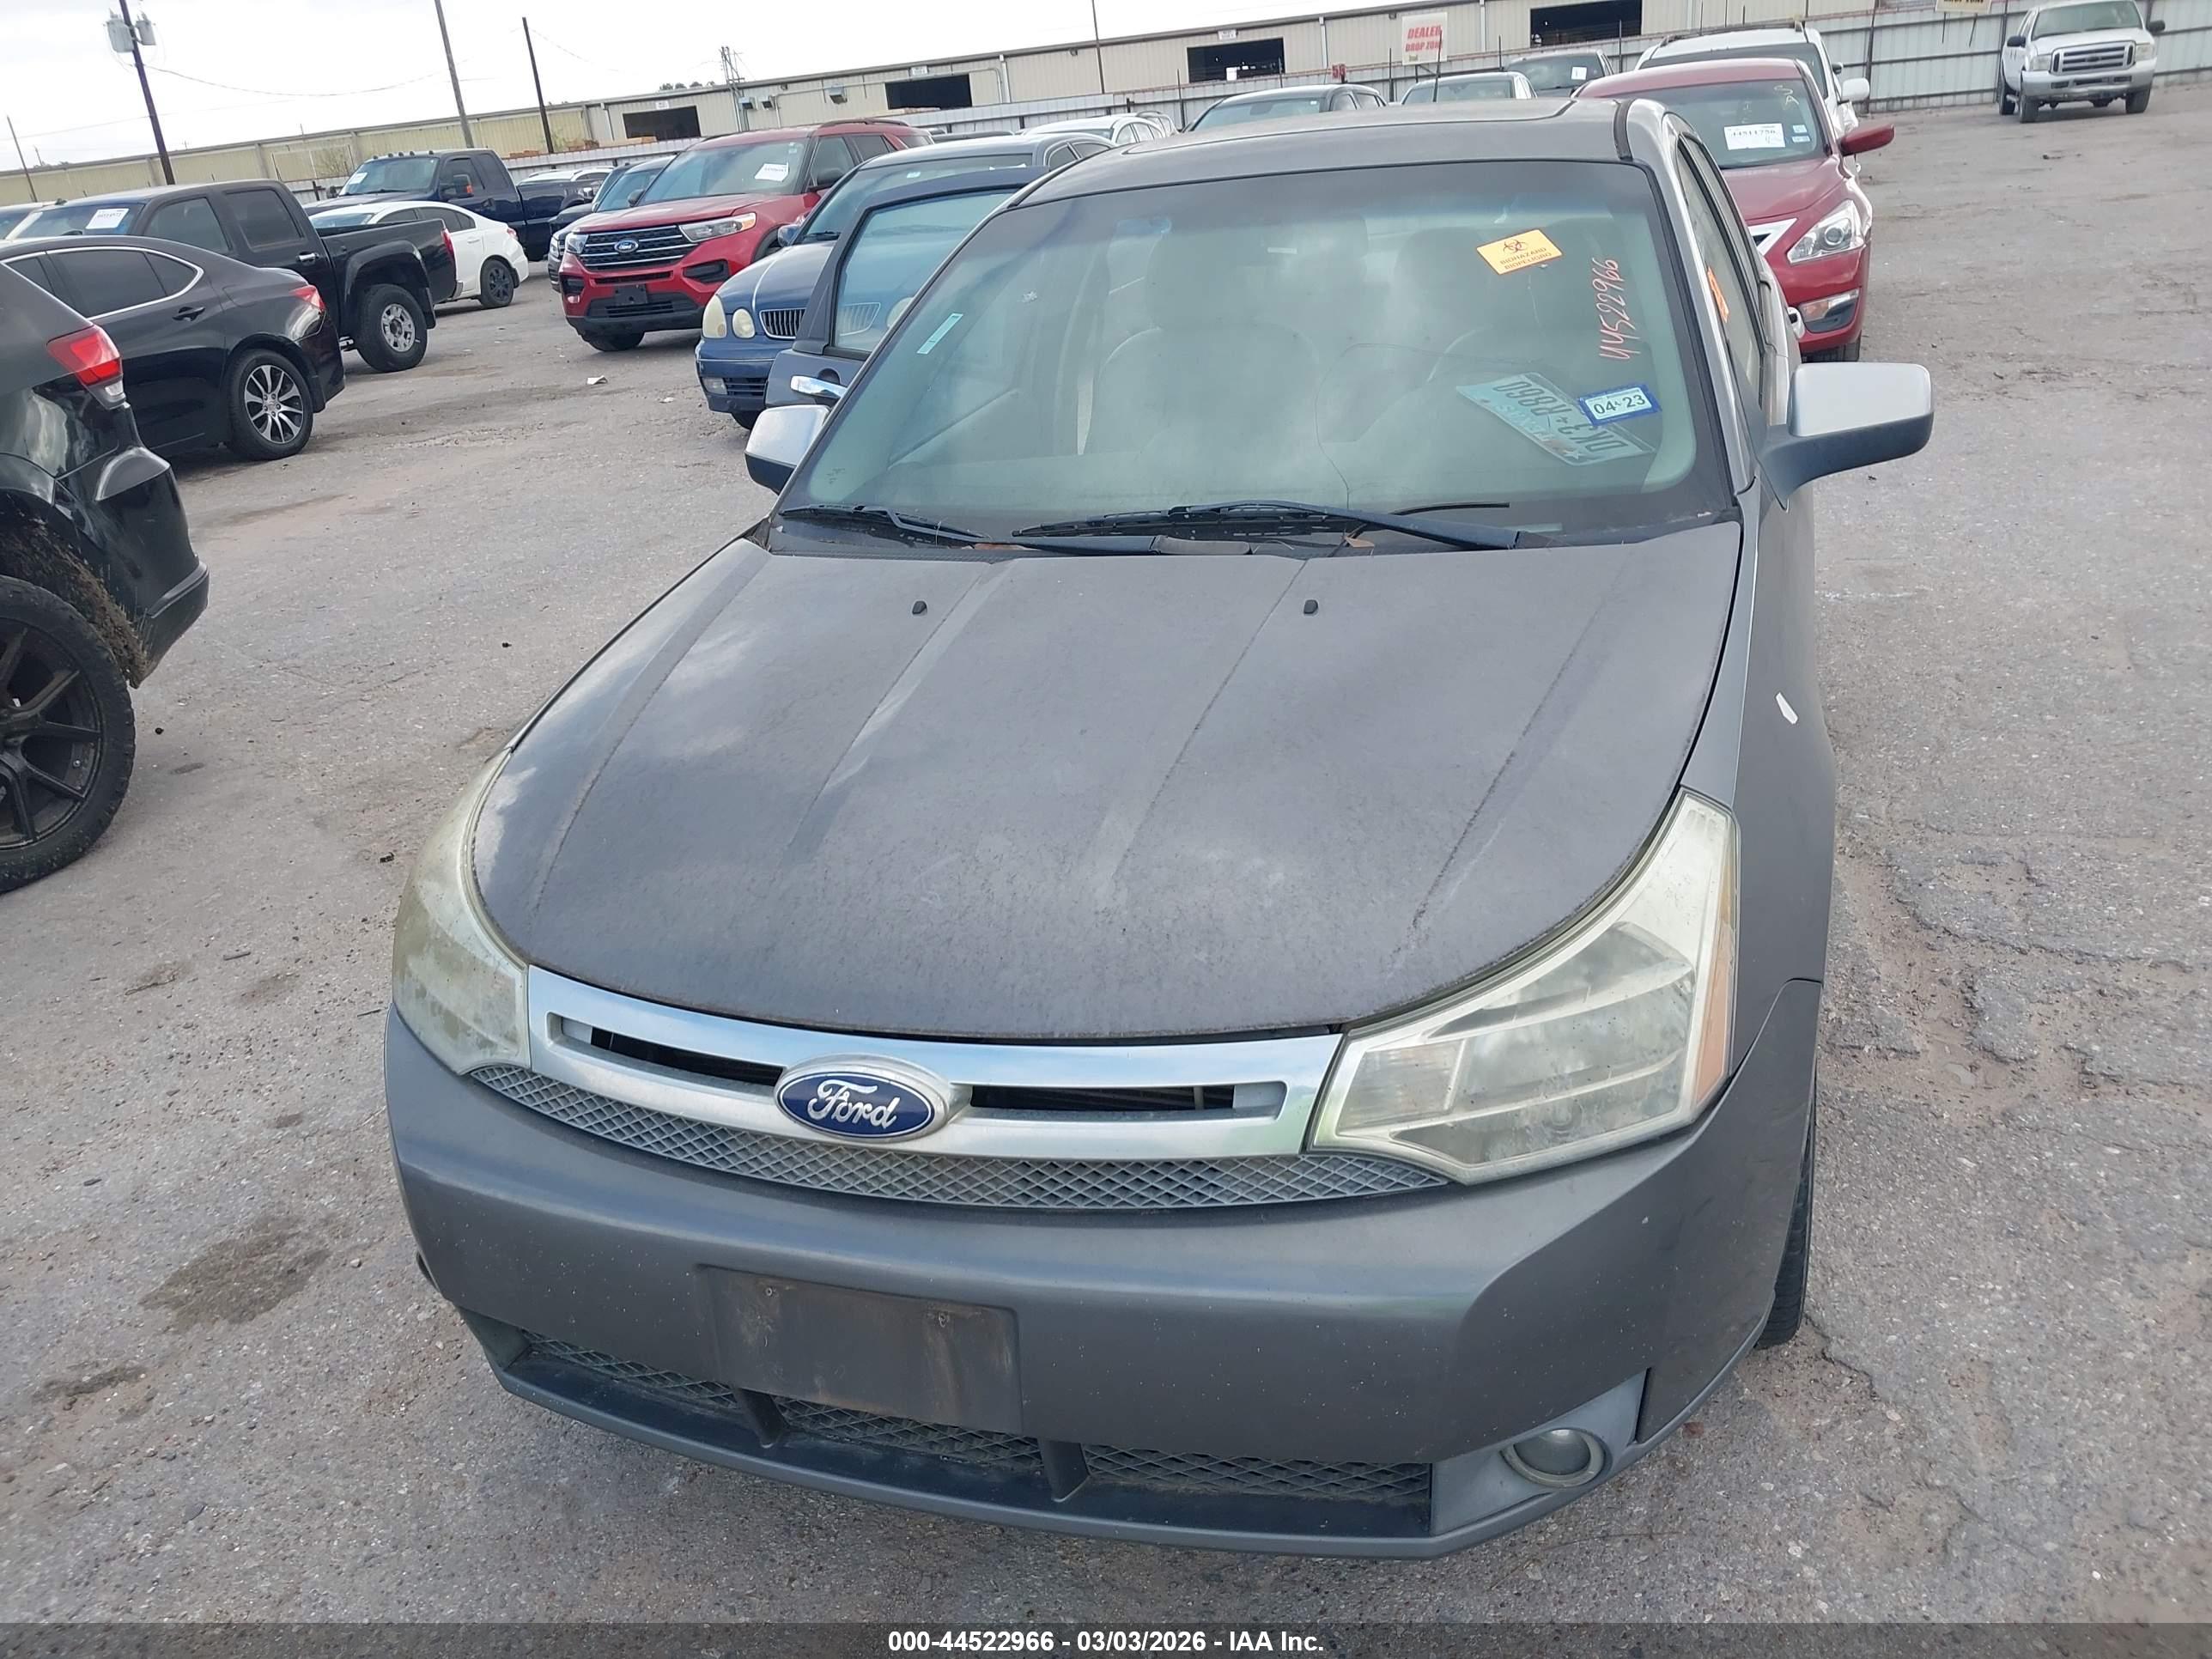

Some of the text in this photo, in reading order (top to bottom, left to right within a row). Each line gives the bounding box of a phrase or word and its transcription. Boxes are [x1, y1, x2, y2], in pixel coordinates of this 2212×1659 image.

[1407, 25, 1442, 40] DEALER
[1405, 42, 1425, 52] DROP
[1500, 247, 1547, 265] BIOHAZARD
[1504, 252, 1552, 270] BIOPELIGRO
[1592, 258, 1641, 359] 44522966
[1593, 401, 1616, 414] 04
[1622, 394, 1646, 408] 23
[807, 1079, 901, 1129] Ford
